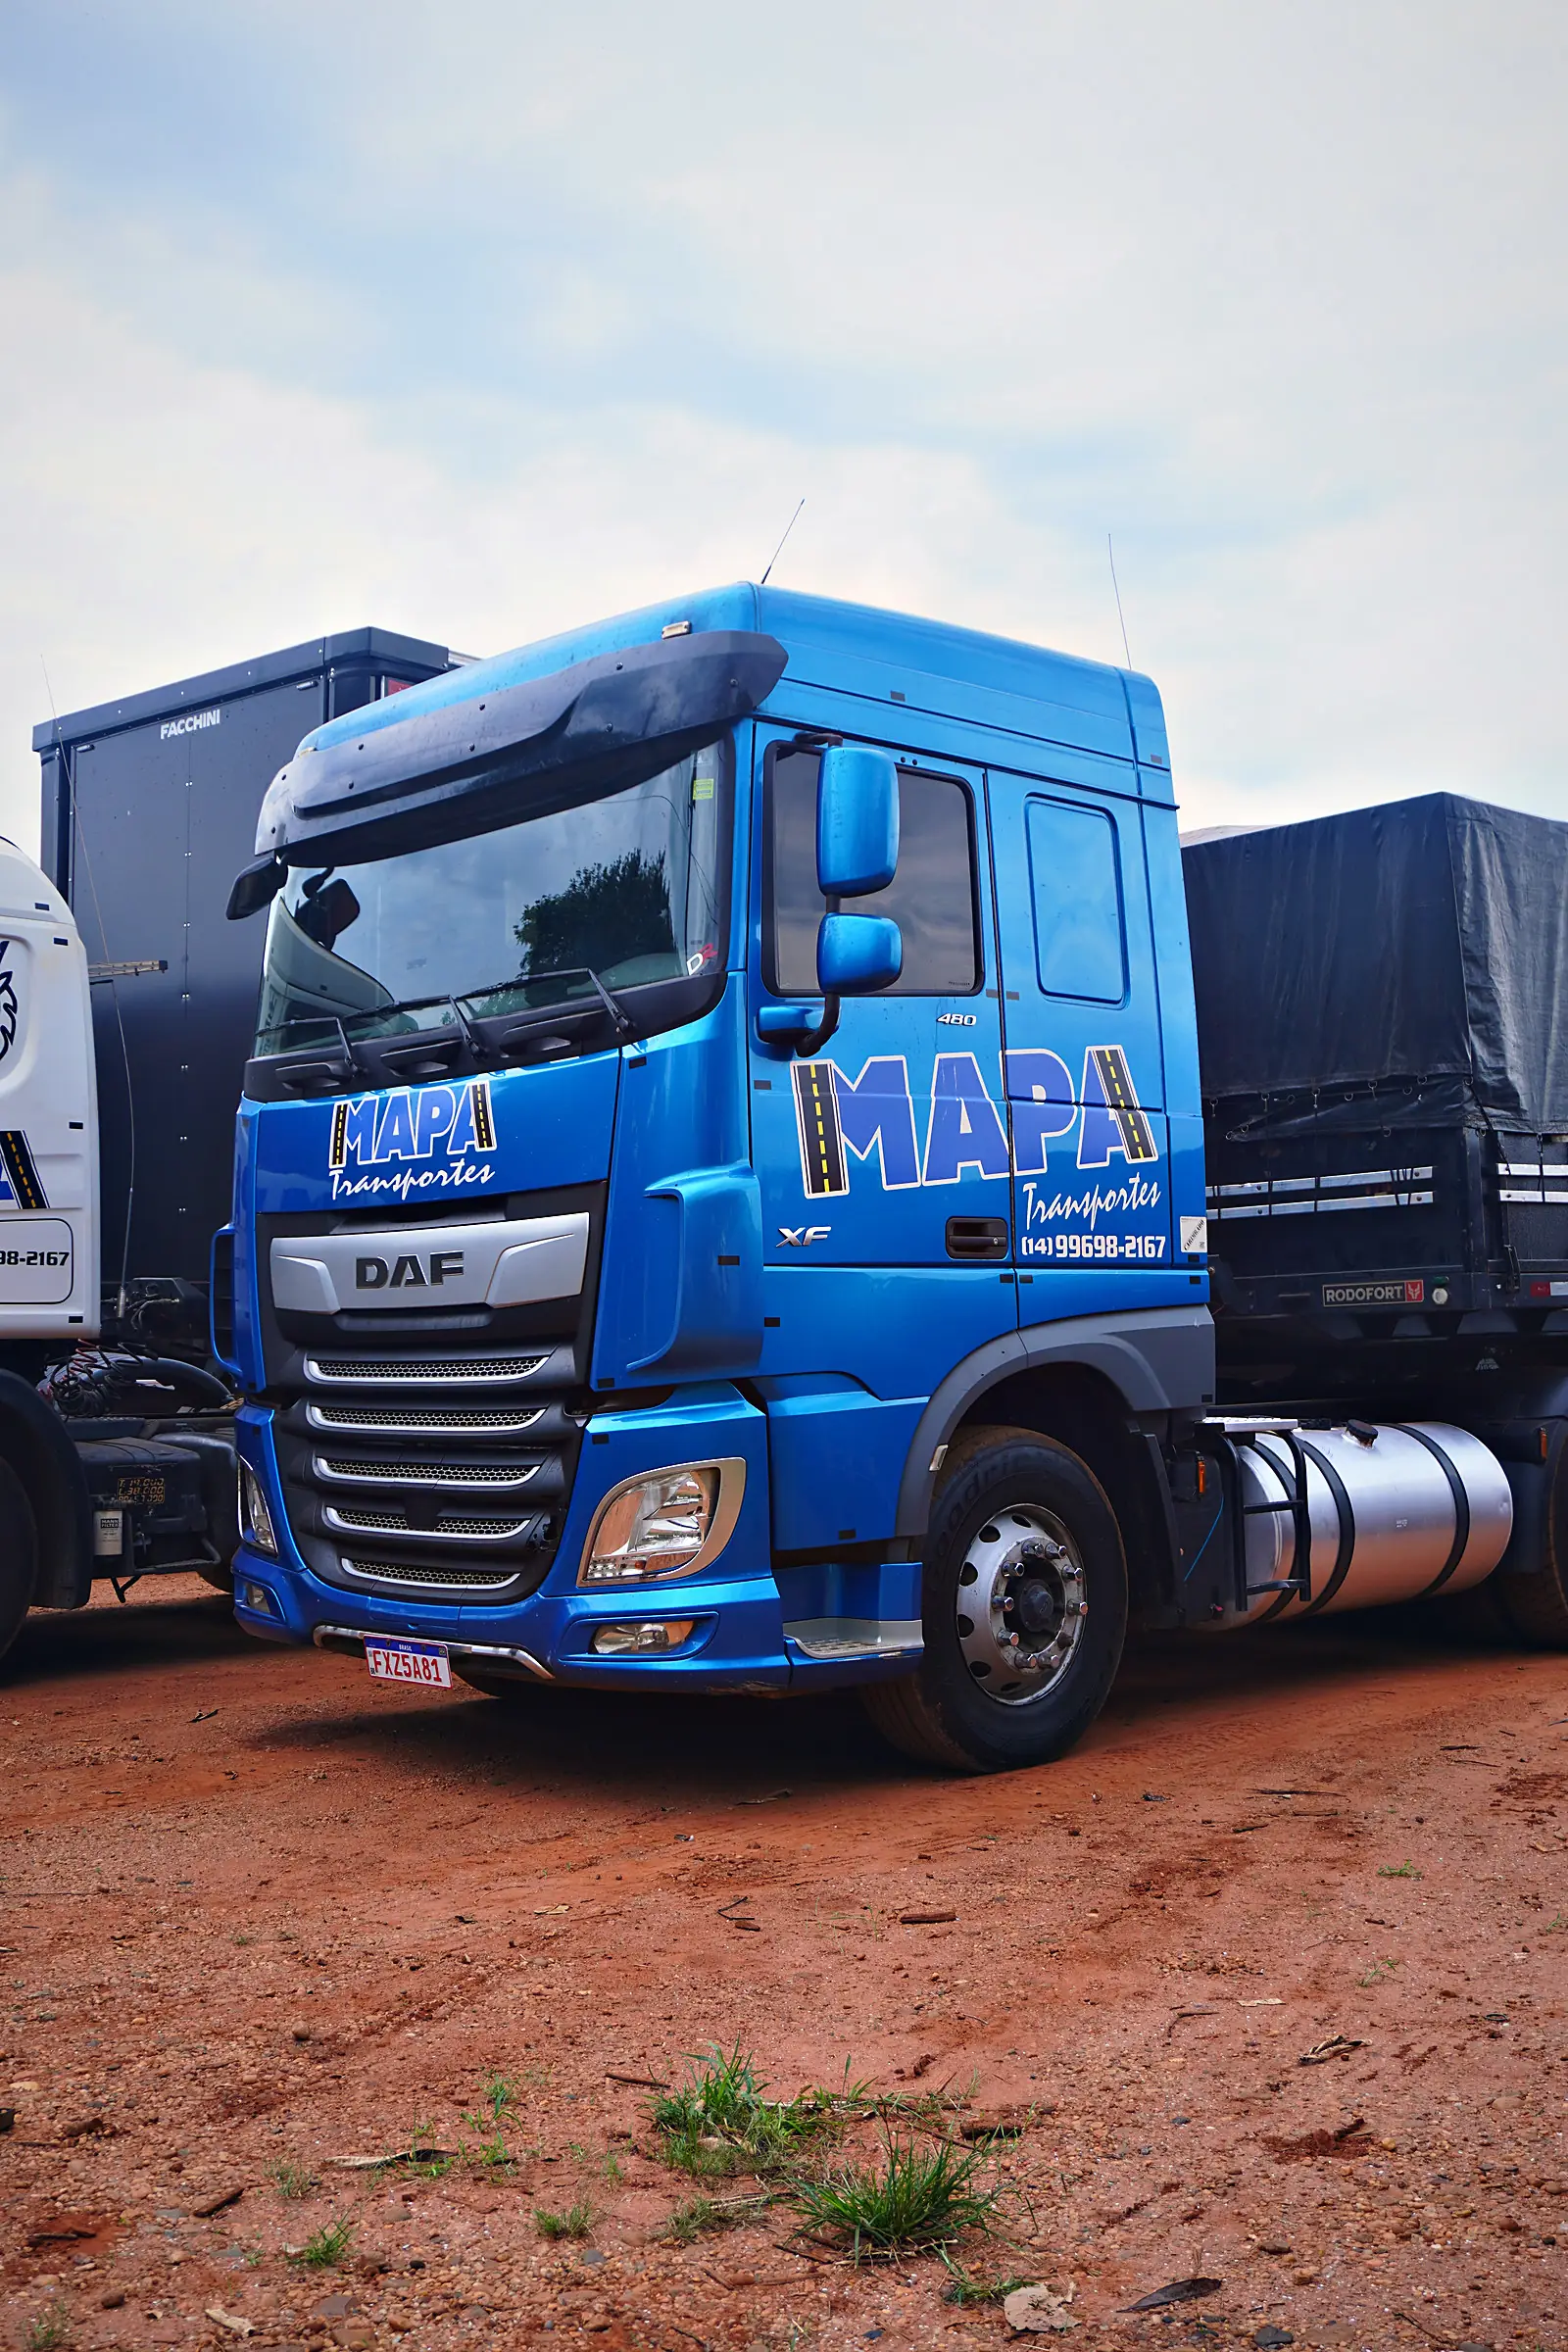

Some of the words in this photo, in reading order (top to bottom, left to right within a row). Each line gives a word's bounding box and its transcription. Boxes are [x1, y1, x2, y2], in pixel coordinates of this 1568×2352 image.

[160, 709, 220, 740] FACCHINI
[936, 1012, 977, 1026] 480
[328, 1080, 498, 1169] MAPA
[790, 1045, 1159, 1200] MAPA
[329, 1157, 496, 1200] Transportes
[1022, 1171, 1162, 1232] Transportes
[775, 1225, 832, 1248] XF
[355, 1250, 466, 1290] DAF
[1326, 1285, 1403, 1302] RODOFORT
[398, 1643, 413, 1652] BRASIL
[371, 1649, 443, 1683] FXZ5A81
